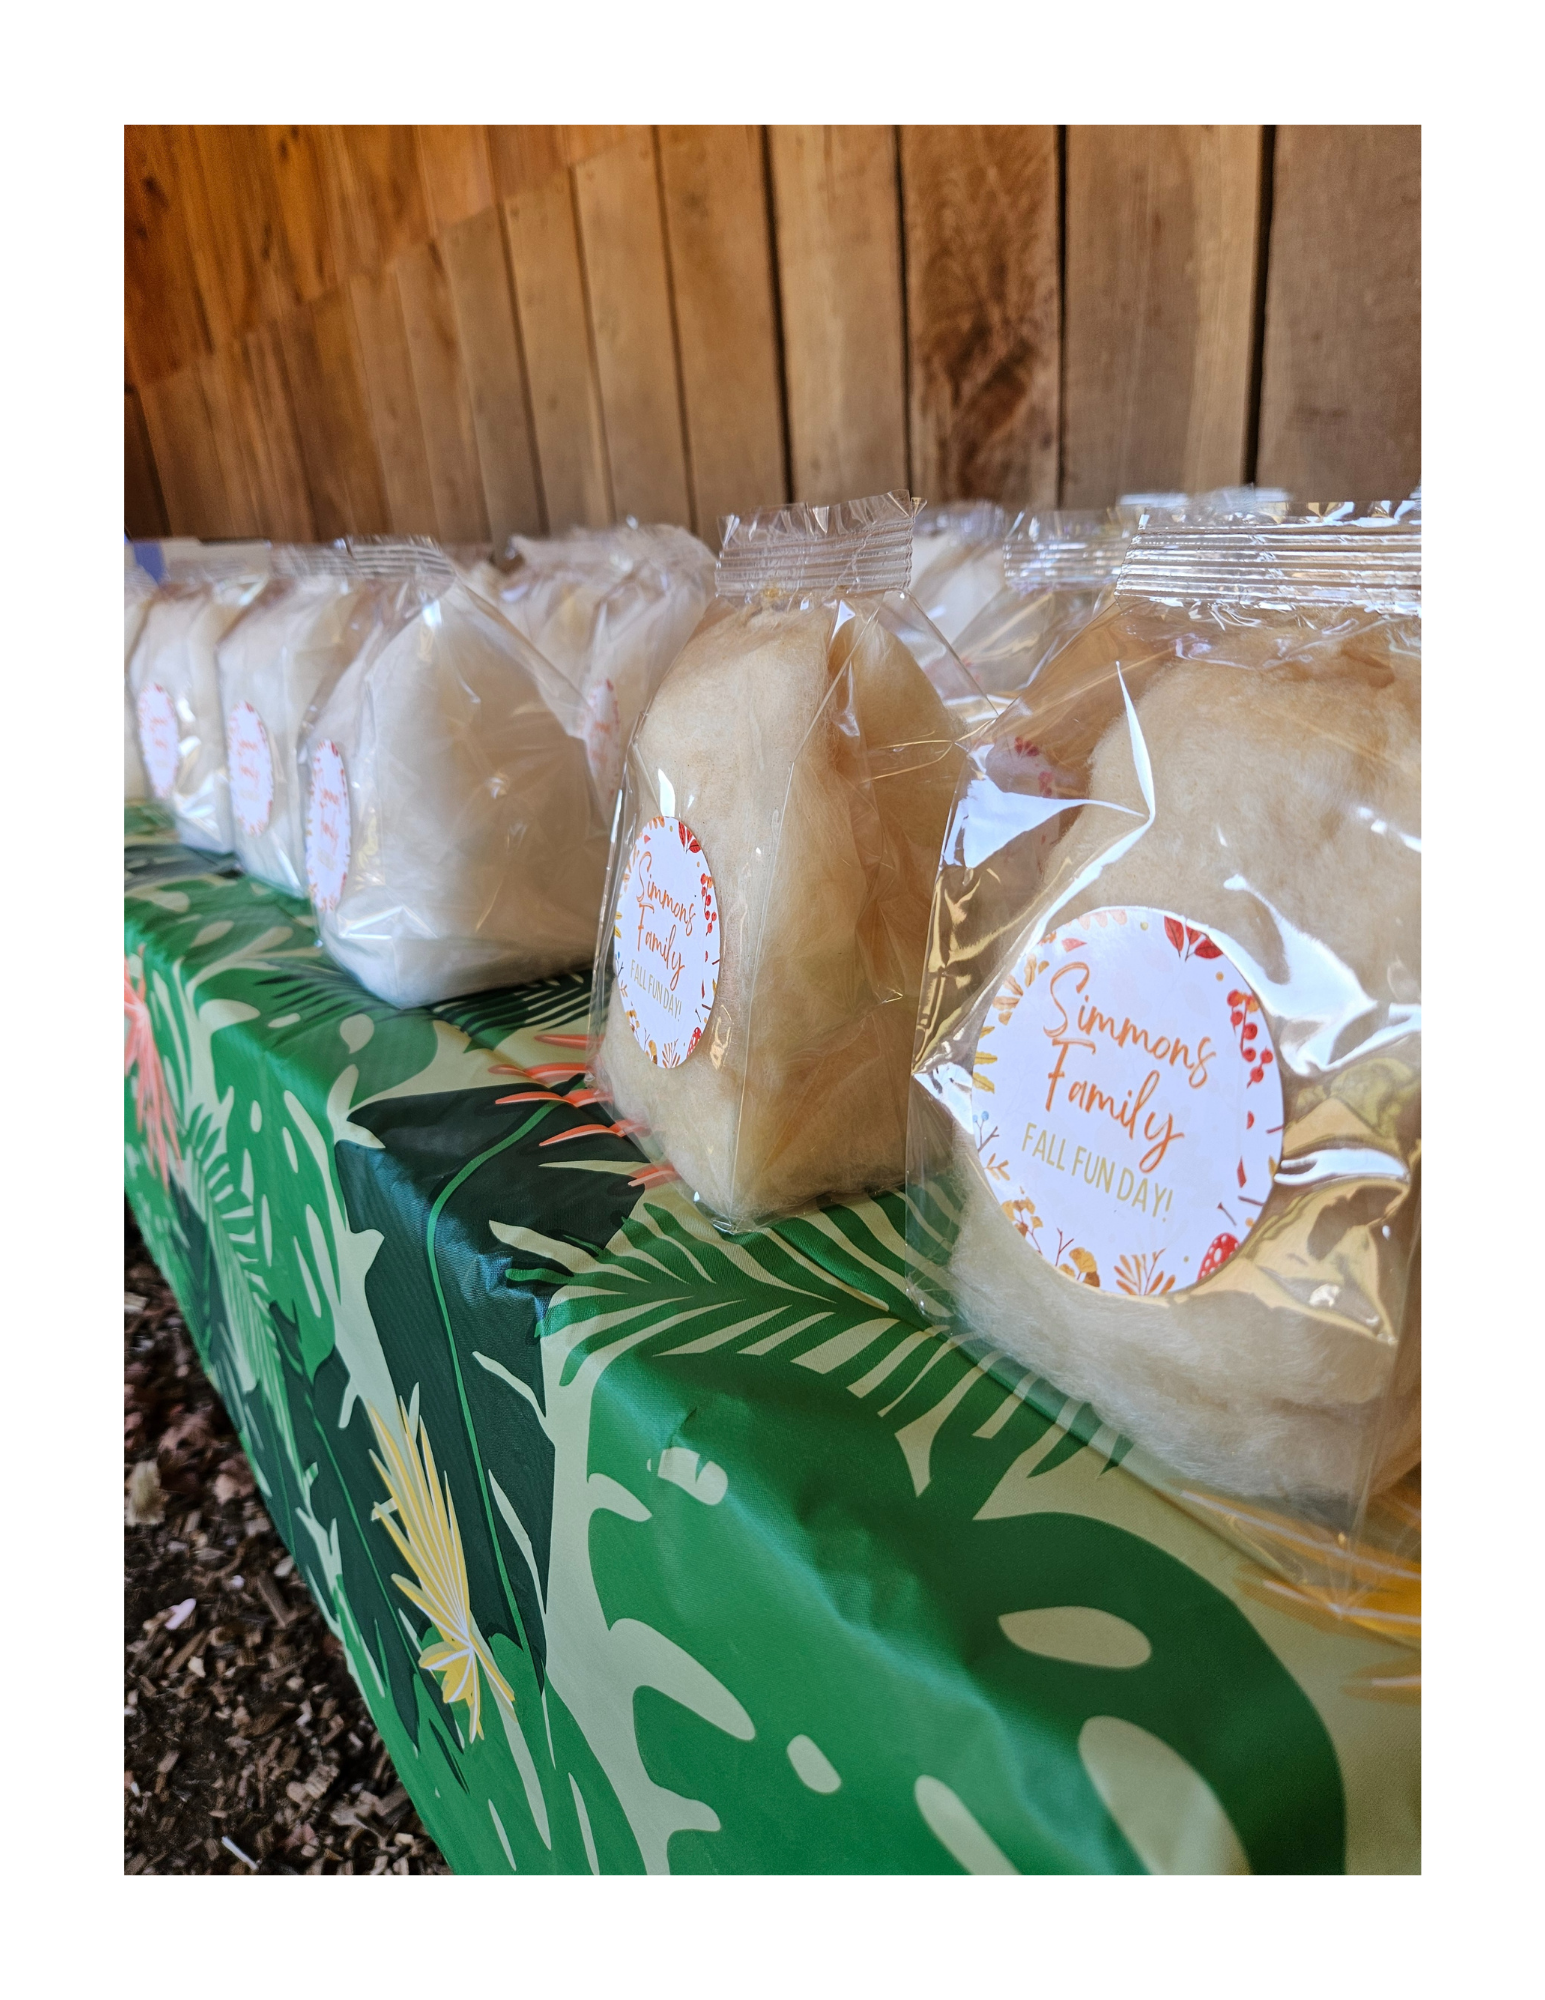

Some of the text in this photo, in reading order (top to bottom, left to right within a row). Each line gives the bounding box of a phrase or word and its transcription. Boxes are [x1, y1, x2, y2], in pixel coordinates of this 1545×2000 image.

[636, 851, 696, 937] Simmons
[630, 959, 682, 1022] FALL FUN DAY!
[637, 902, 685, 991] Family
[1043, 962, 1216, 1089] Simmons
[1045, 1038, 1185, 1173] Family
[1021, 1122, 1174, 1222] FALL FUN DAY!
